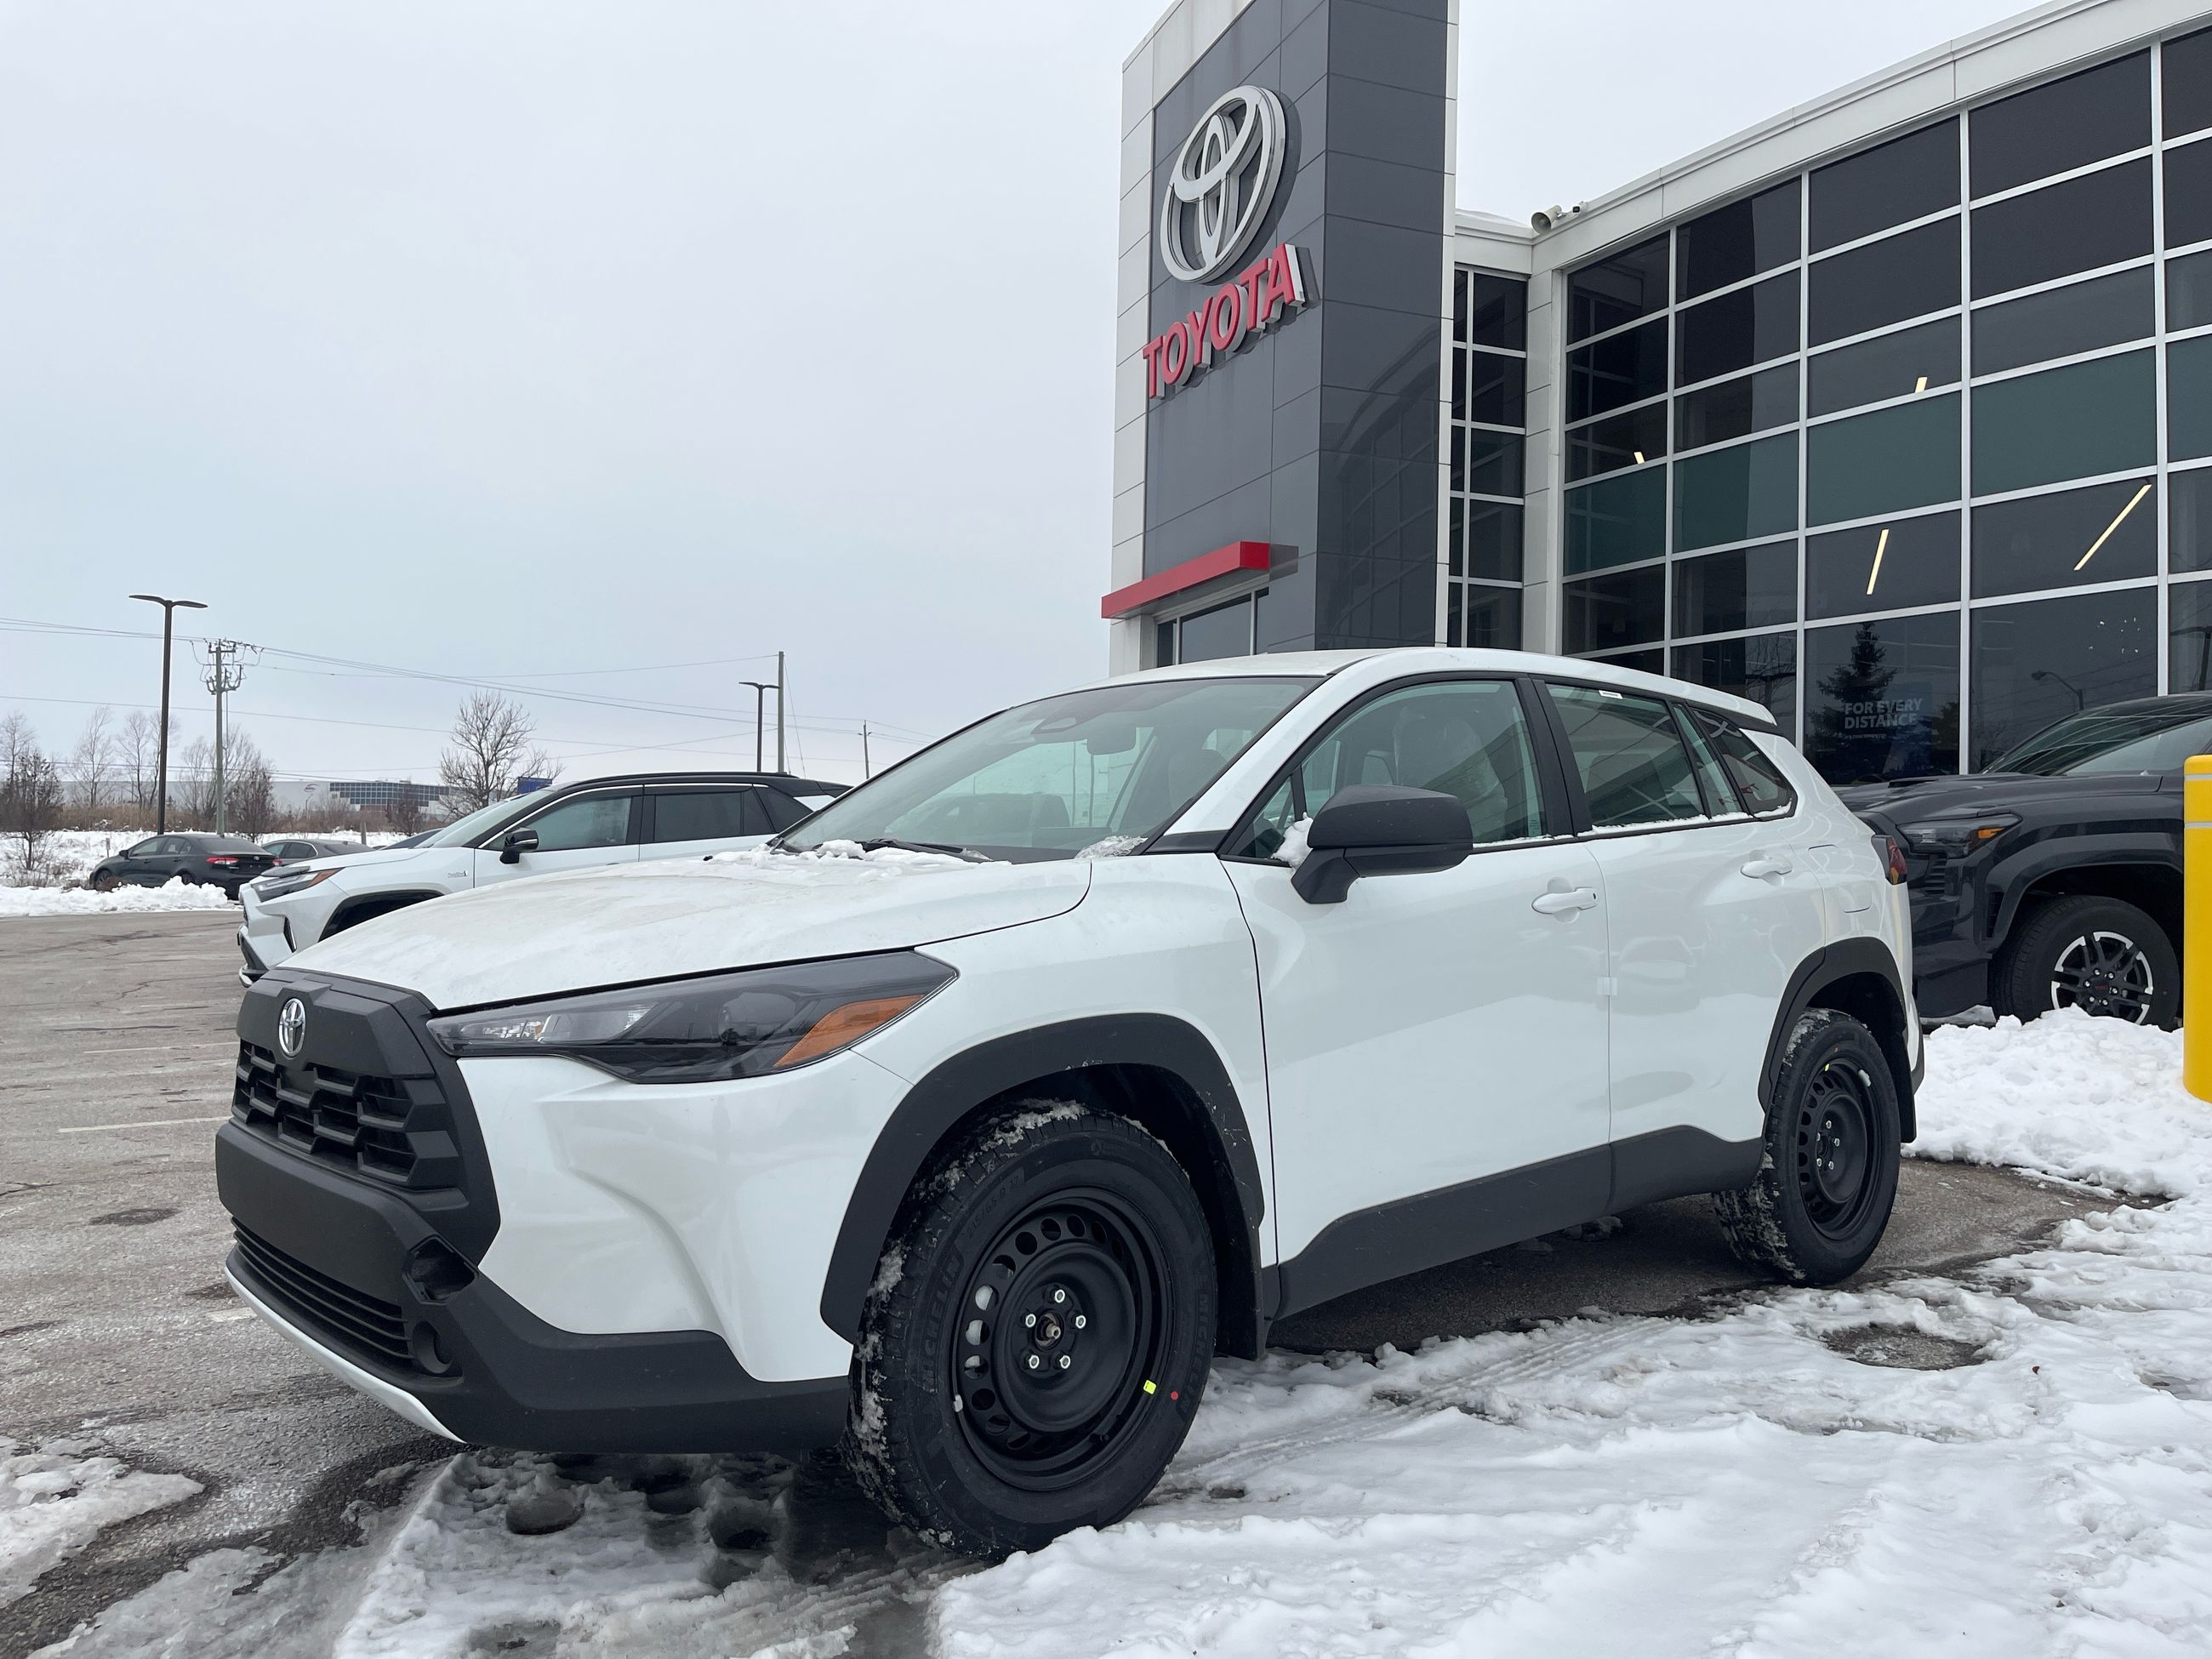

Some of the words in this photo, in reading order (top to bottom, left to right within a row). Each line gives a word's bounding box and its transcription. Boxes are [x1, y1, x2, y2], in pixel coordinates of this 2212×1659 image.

[1143, 242, 1303, 400] TOYOTA
[1844, 702, 1873, 715] FOR
[1876, 698, 1923, 714] EVERY
[1844, 713, 1918, 730] DISTANCE
[922, 1252, 961, 1393] MICHELIN
[1180, 1292, 1210, 1416] MICHELIN
